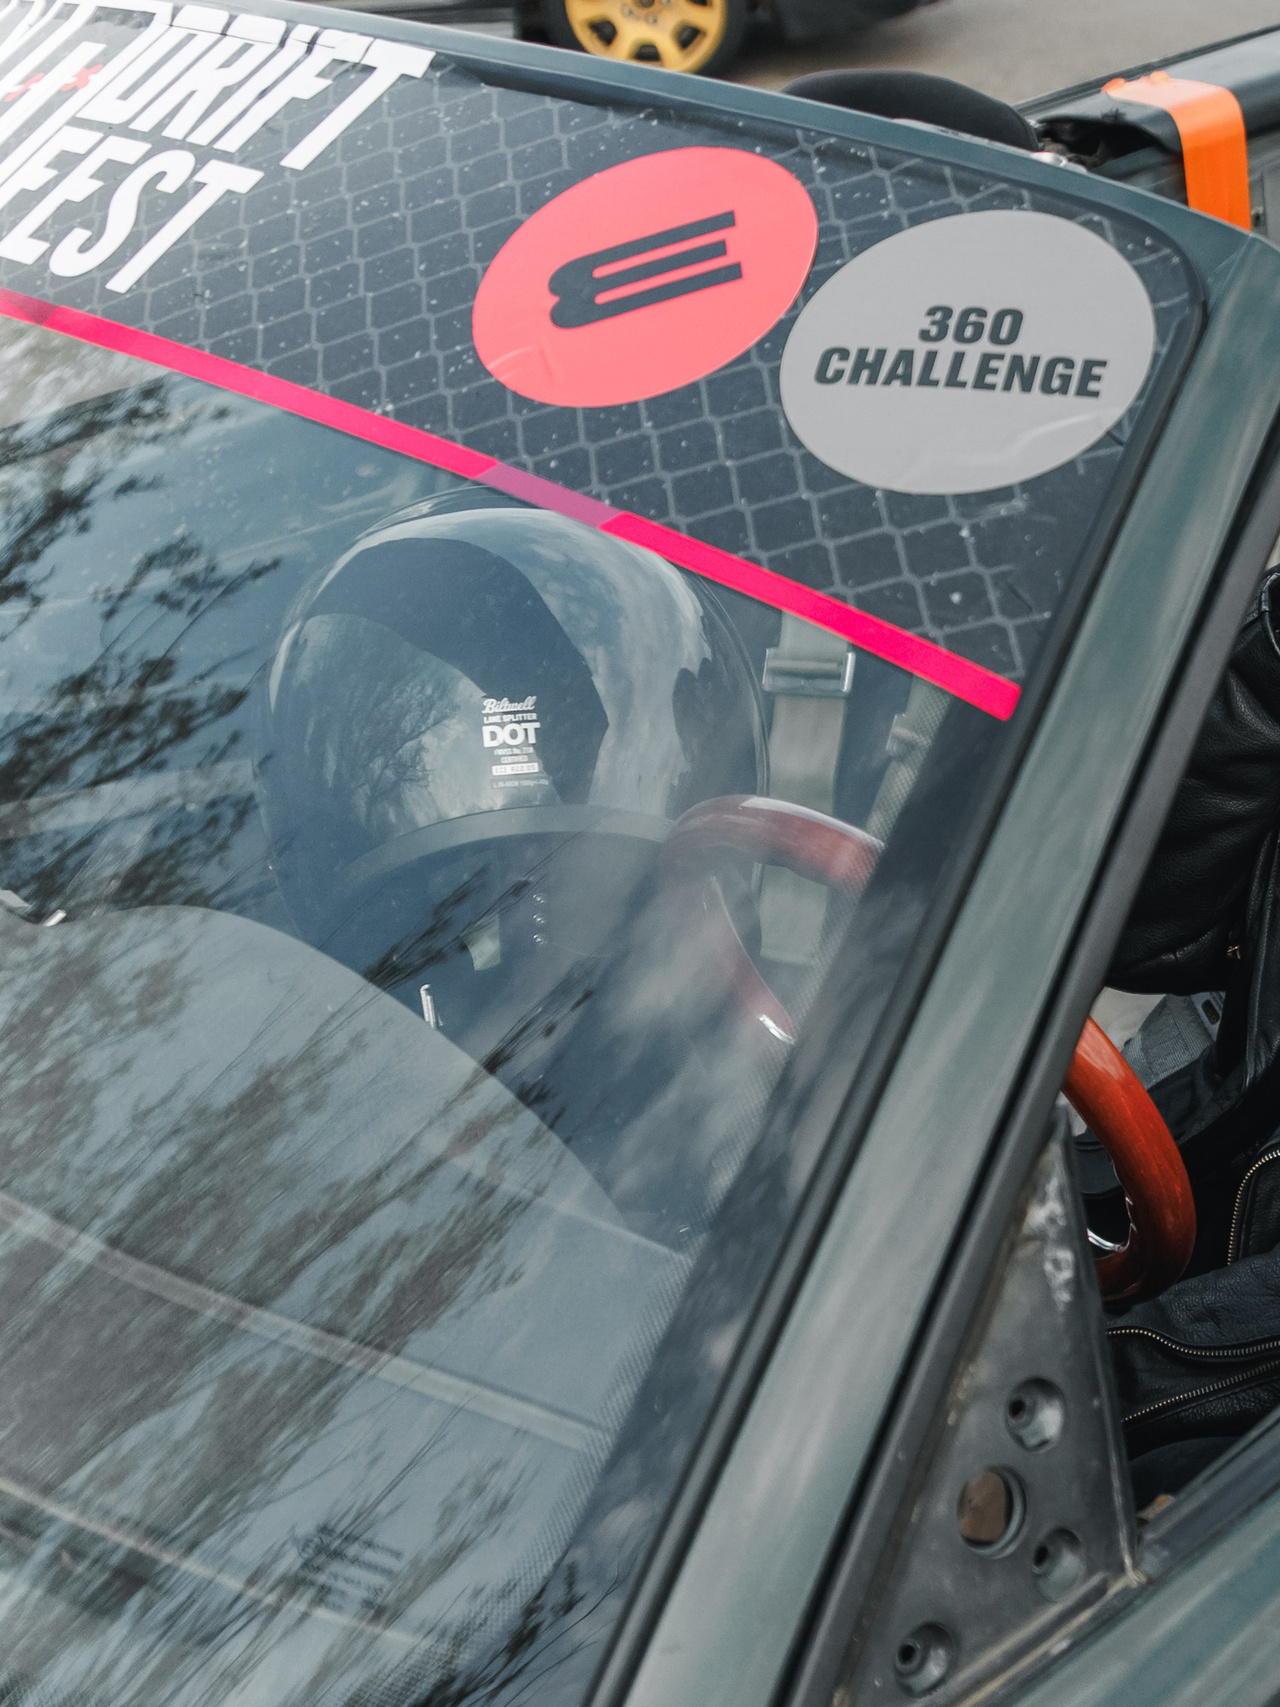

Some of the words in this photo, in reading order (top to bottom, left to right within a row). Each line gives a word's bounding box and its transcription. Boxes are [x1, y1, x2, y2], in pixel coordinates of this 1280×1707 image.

[75, 4, 437, 171] DRIFT
[0, 125, 265, 294] FEST
[918, 304, 1024, 347] 360
[813, 347, 1108, 399] CHALLENGE
[481, 696, 537, 714] Biltwell
[502, 713, 537, 722] SPLITTER
[482, 722, 541, 747] DOT
